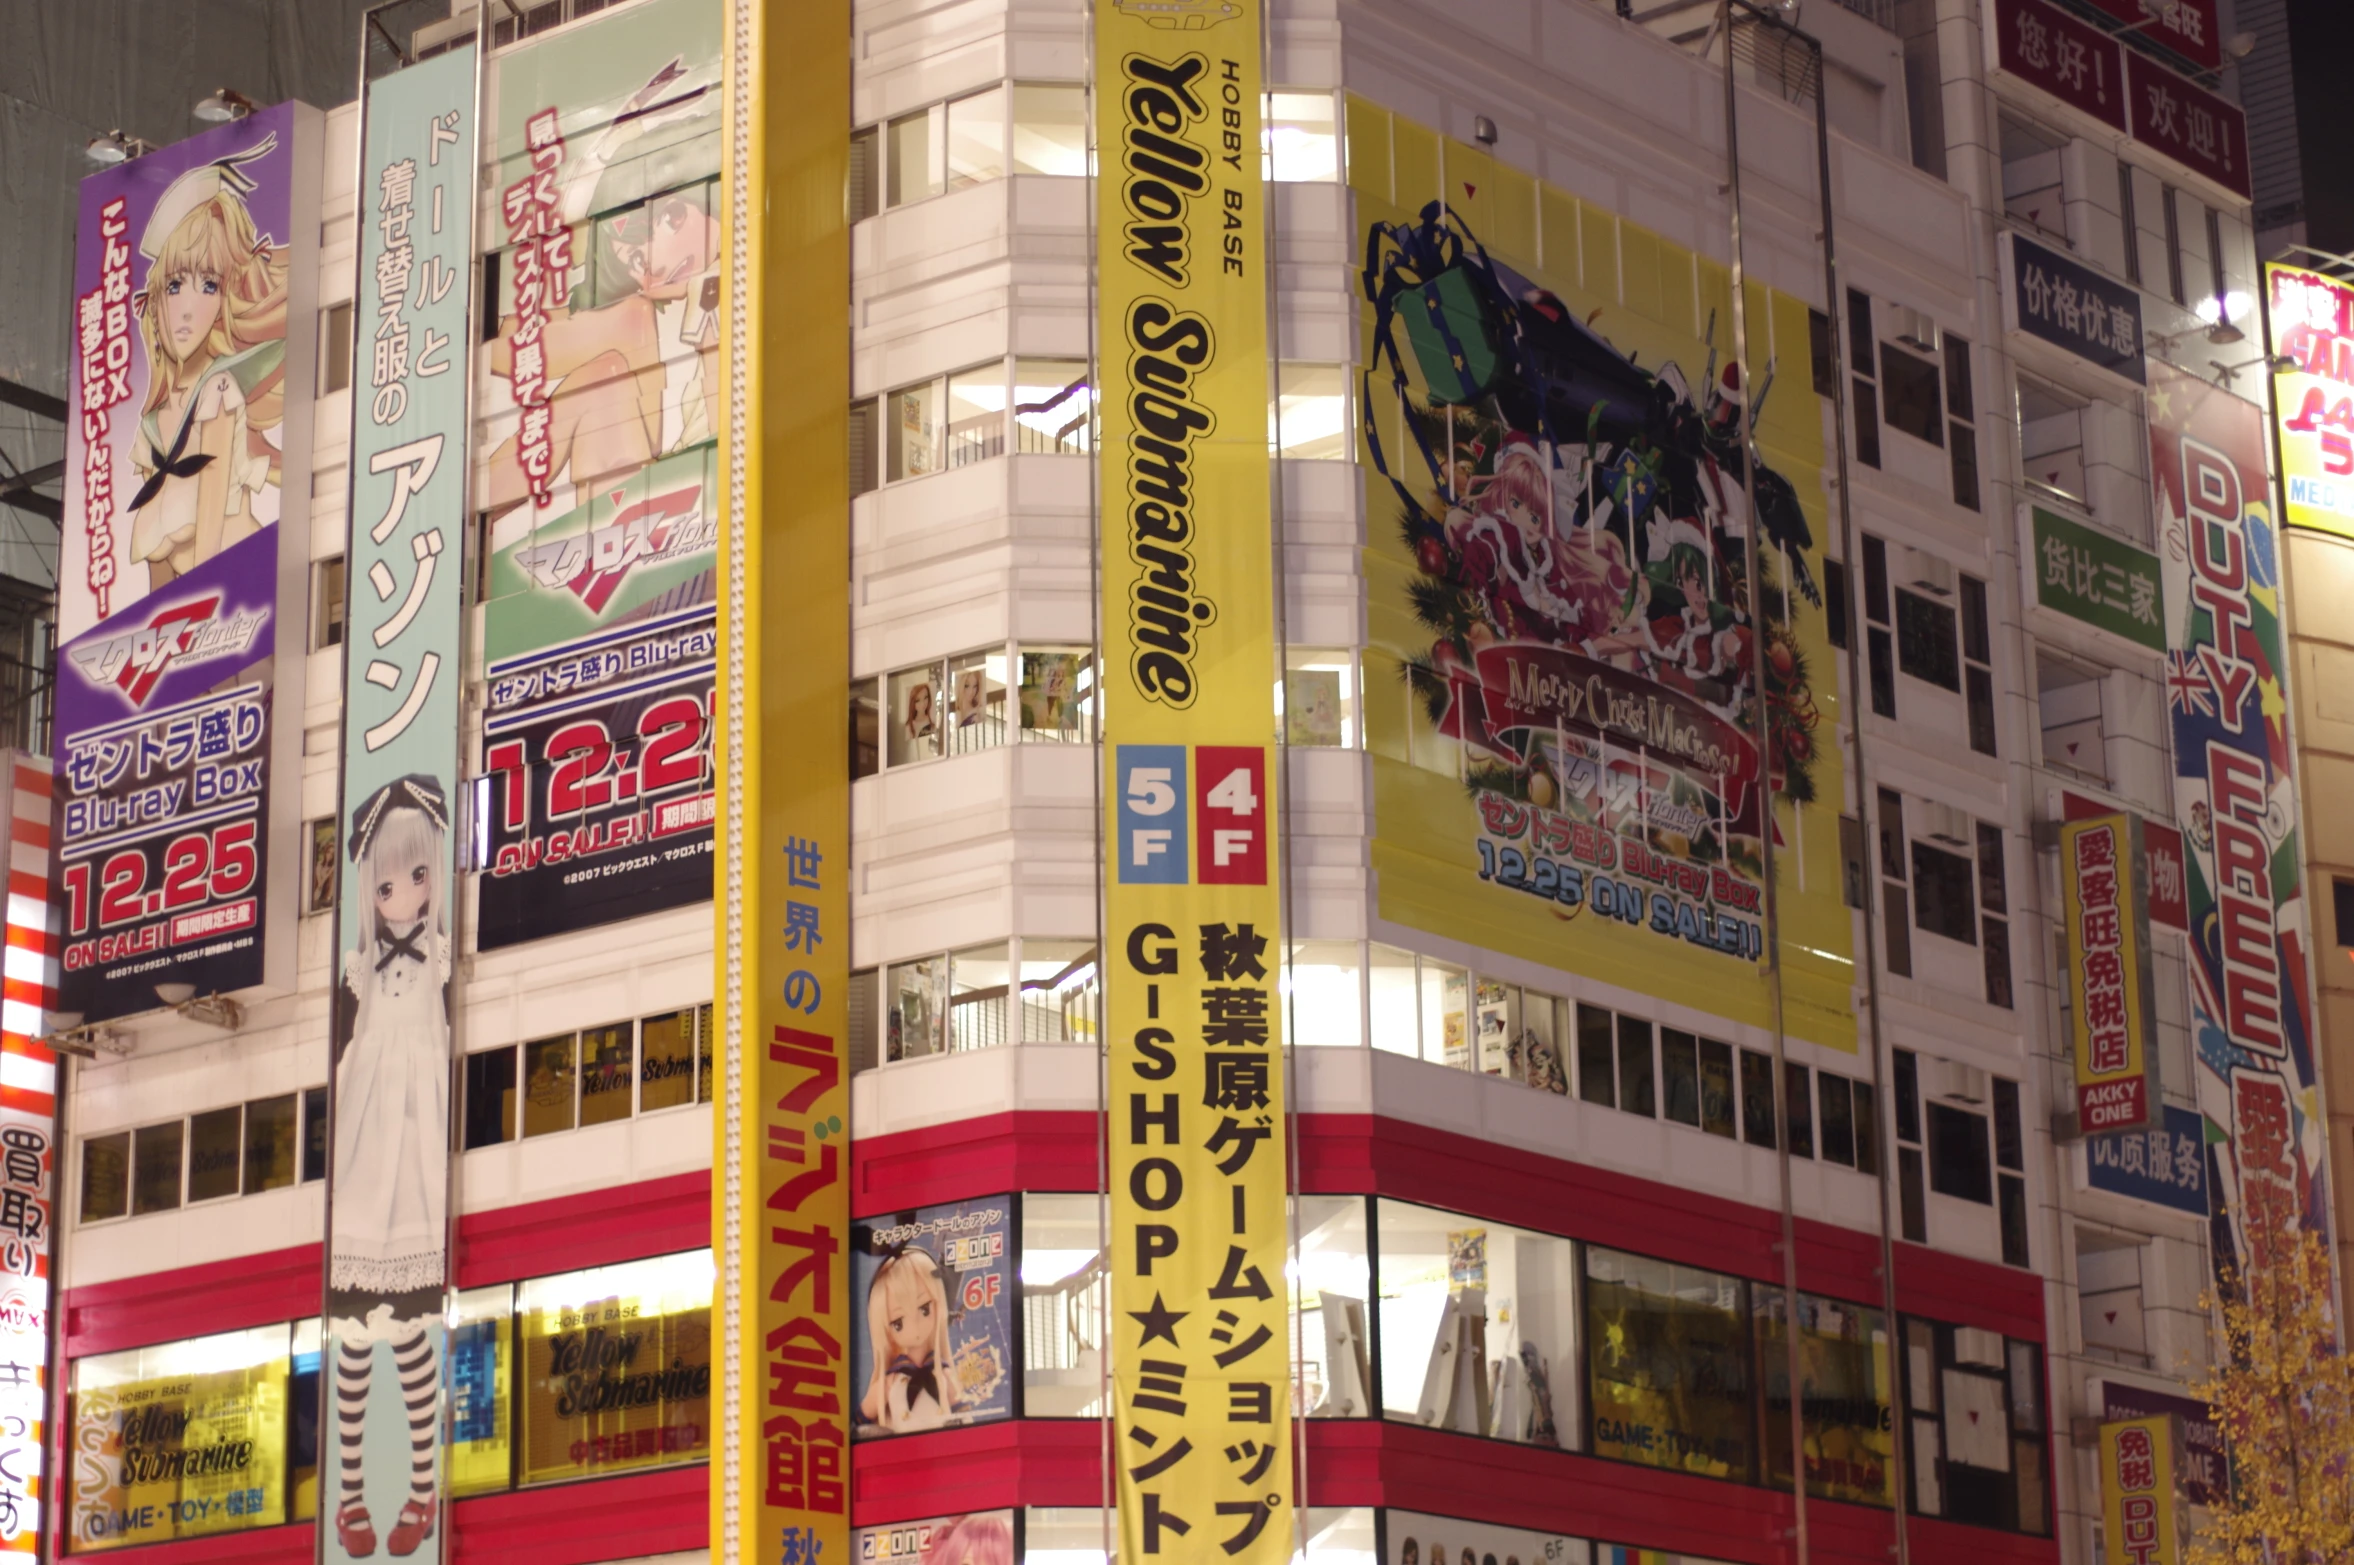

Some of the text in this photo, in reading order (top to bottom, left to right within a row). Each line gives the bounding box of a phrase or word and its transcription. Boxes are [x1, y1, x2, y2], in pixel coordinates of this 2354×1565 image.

[2016, 9, 2107, 105] 您好!
[1221, 58, 1243, 277] HOBBY BASE
[2147, 83, 2232, 172] 欢迎!
[414, 110, 459, 378] ドールと
[101, 199, 133, 403] こんなBOX
[372, 157, 416, 426] 着せ替え服の
[2022, 262, 2138, 359] 价格优惠
[1126, 55, 1213, 704] Yellow Submarine
[79, 296, 115, 618] 滅多にないんだからね!
[364, 433, 445, 753] アゾン
[2042, 534, 2159, 626] 货比三家
[2181, 436, 2253, 734] DUTY
[70, 617, 191, 686] マクロス
[494, 652, 622, 707] ゼントラ盛り
[1504, 657, 1585, 719] Merry
[67, 703, 263, 792] ゼントラ盛り
[488, 690, 717, 831] 12.2
[65, 759, 261, 839] Blu-ray Box
[1127, 767, 1258, 866] 5F 4F
[63, 820, 257, 935] 12.25
[492, 838, 543, 877] ON
[1477, 838, 1584, 905] 12.25
[1591, 875, 1643, 925] ON
[1478, 791, 1762, 914] ゼントラ盛り Blu-ray Box
[782, 834, 823, 1015] 世界の
[2206, 738, 2288, 1062] FREE
[65, 939, 96, 971] ON
[2084, 1080, 2138, 1106] AKKY
[2090, 1102, 2134, 1126] ONE
[2, 1129, 46, 1276] 買取り
[873, 1209, 1002, 1245] キャラクタードールのアゾン
[1198, 921, 1282, 1556] 秋葉原ゲームショップ
[763, 1024, 845, 1514] ラジオ会館
[945, 1232, 1003, 1265] azone
[963, 1274, 1001, 1310] 6F
[549, 1326, 643, 1377] Yellow
[553, 1305, 640, 1328] HOBBY BASE
[117, 1383, 192, 1404] HOBBY BASE
[119, 1400, 193, 1448] Yellow
[555, 1356, 711, 1420] Submarine
[120, 1432, 254, 1489] Submarine
